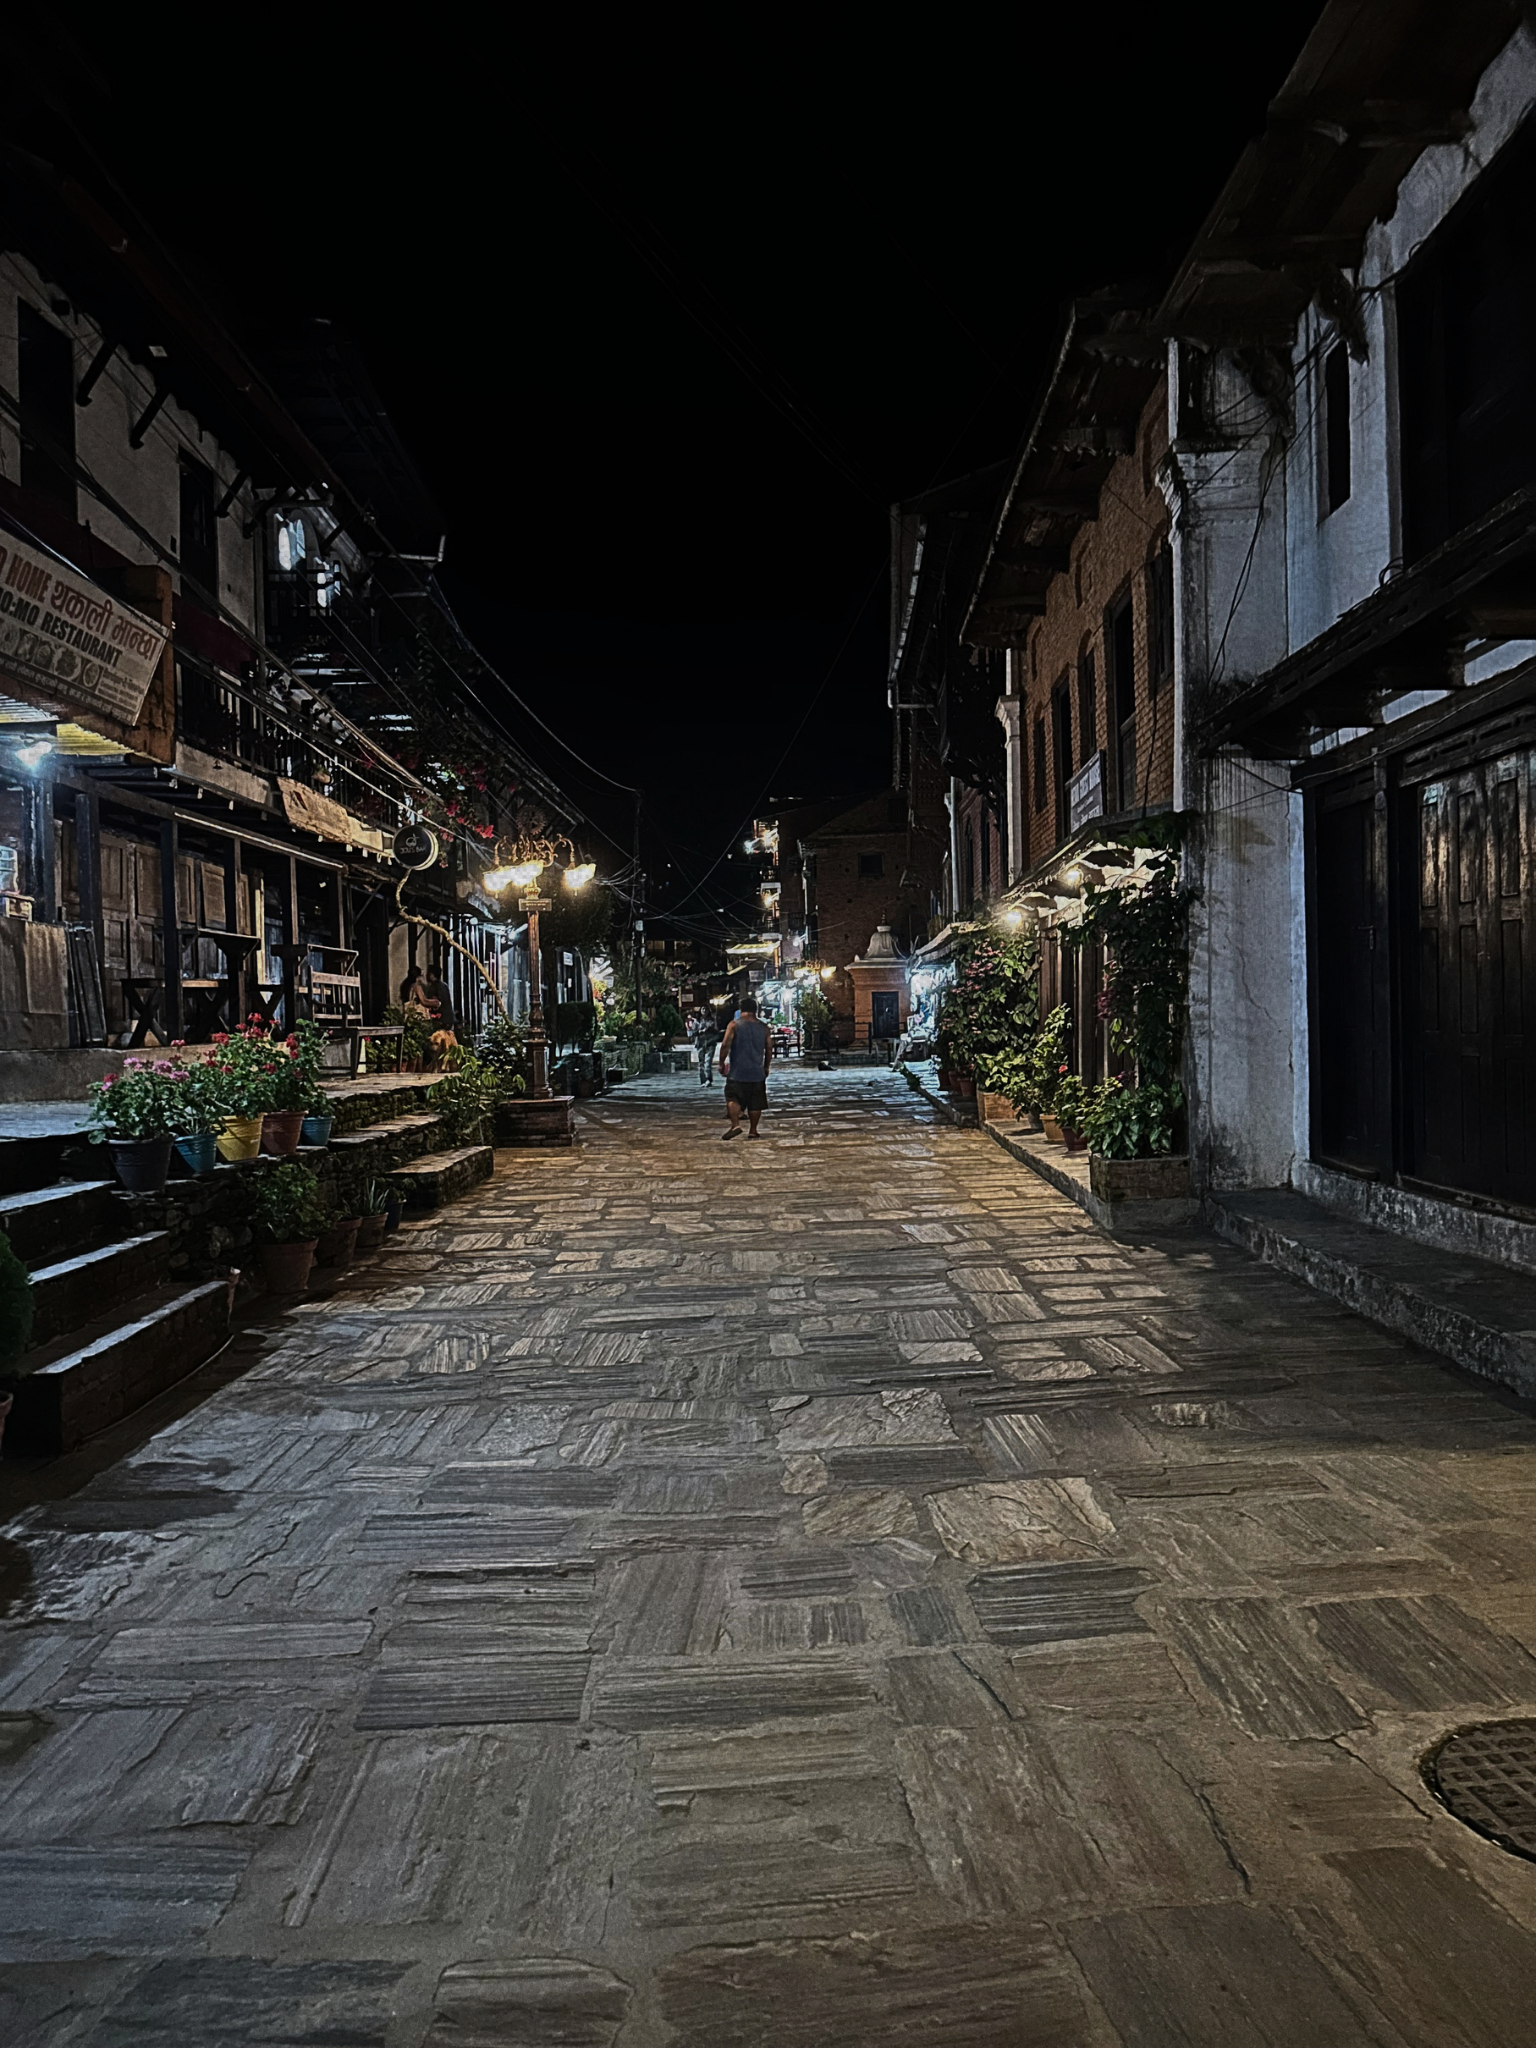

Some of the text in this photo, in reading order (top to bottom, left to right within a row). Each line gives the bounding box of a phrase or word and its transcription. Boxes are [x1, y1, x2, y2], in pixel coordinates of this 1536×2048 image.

[0, 587, 123, 667] O:MO RESTAURANT
[5, 553, 53, 604] HOME
[51, 580, 113, 637] थकाली
[111, 615, 161, 662] भान्छा
